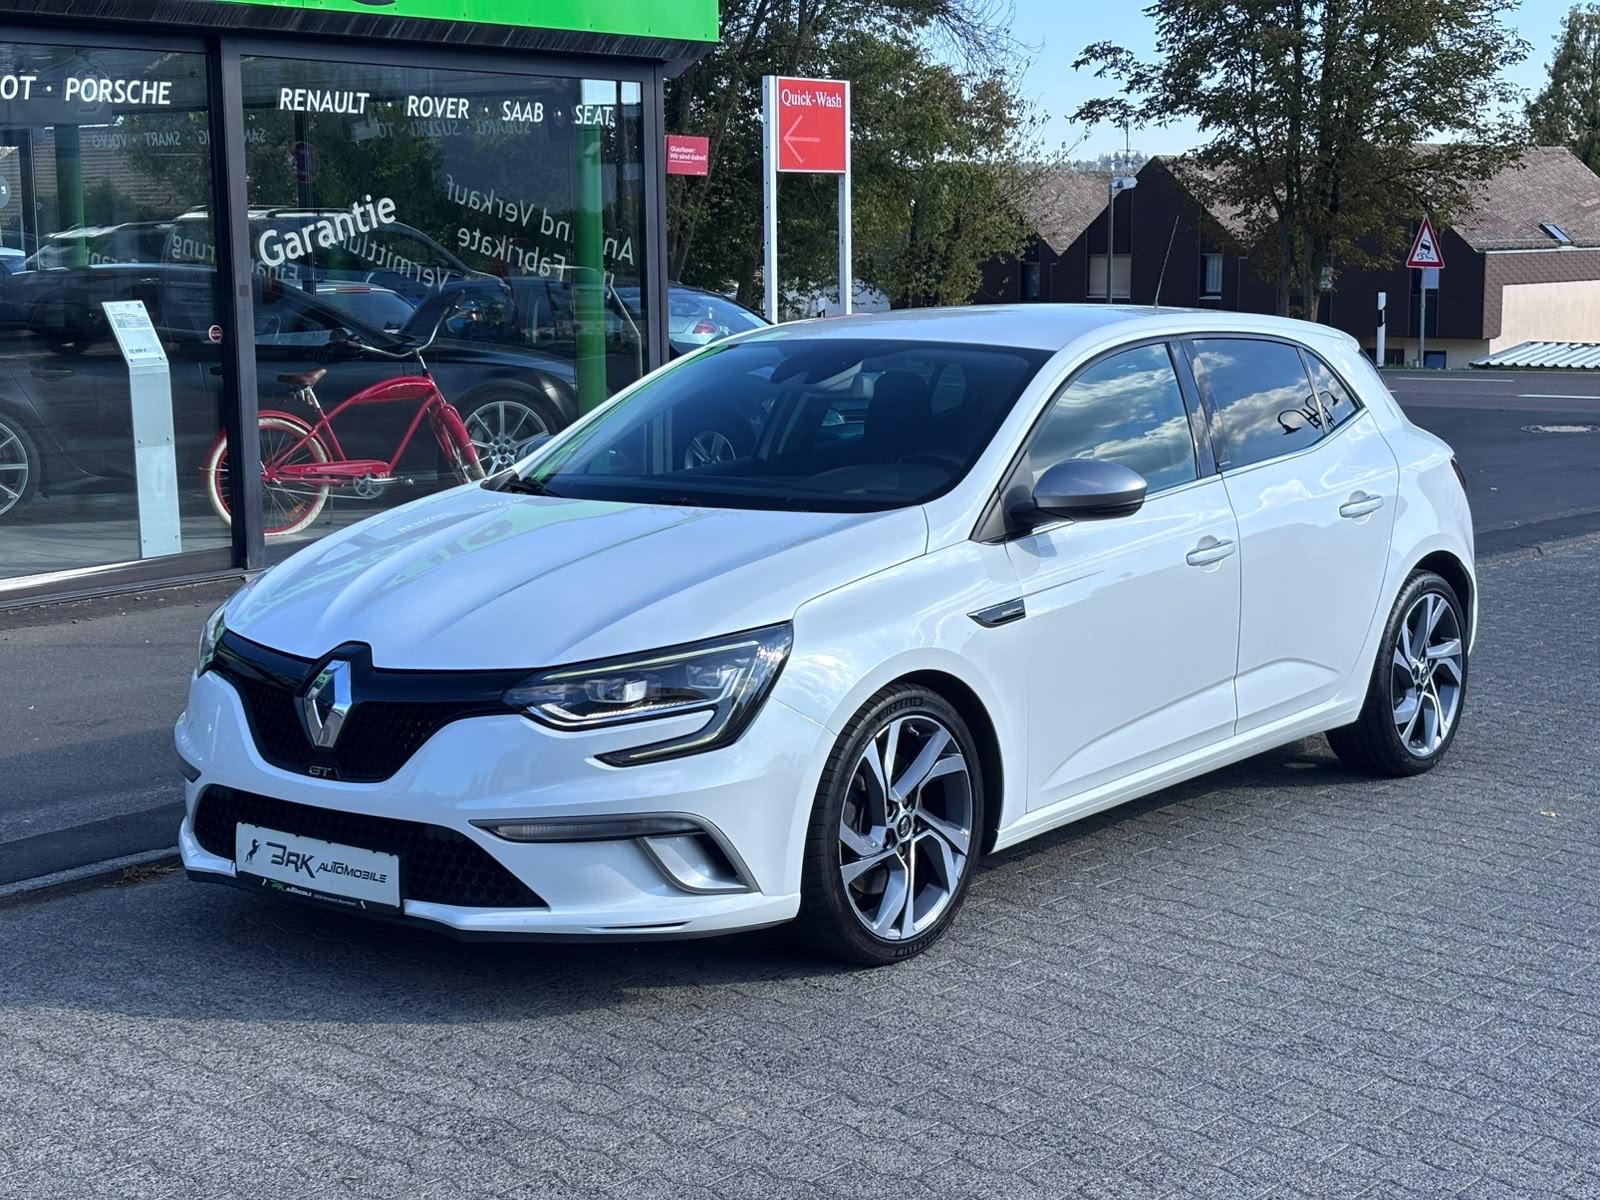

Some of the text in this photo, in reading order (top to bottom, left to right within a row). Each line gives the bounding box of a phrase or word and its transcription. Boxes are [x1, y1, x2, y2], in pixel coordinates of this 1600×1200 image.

[65, 78, 172, 105] PORSCHE
[279, 87, 614, 126] RENAULT ROVER SAAB SEAT
[781, 88, 842, 108] Quick-Wash
[258, 194, 397, 267] Garantie
[308, 765, 332, 777] GT
[266, 841, 316, 879] BRK
